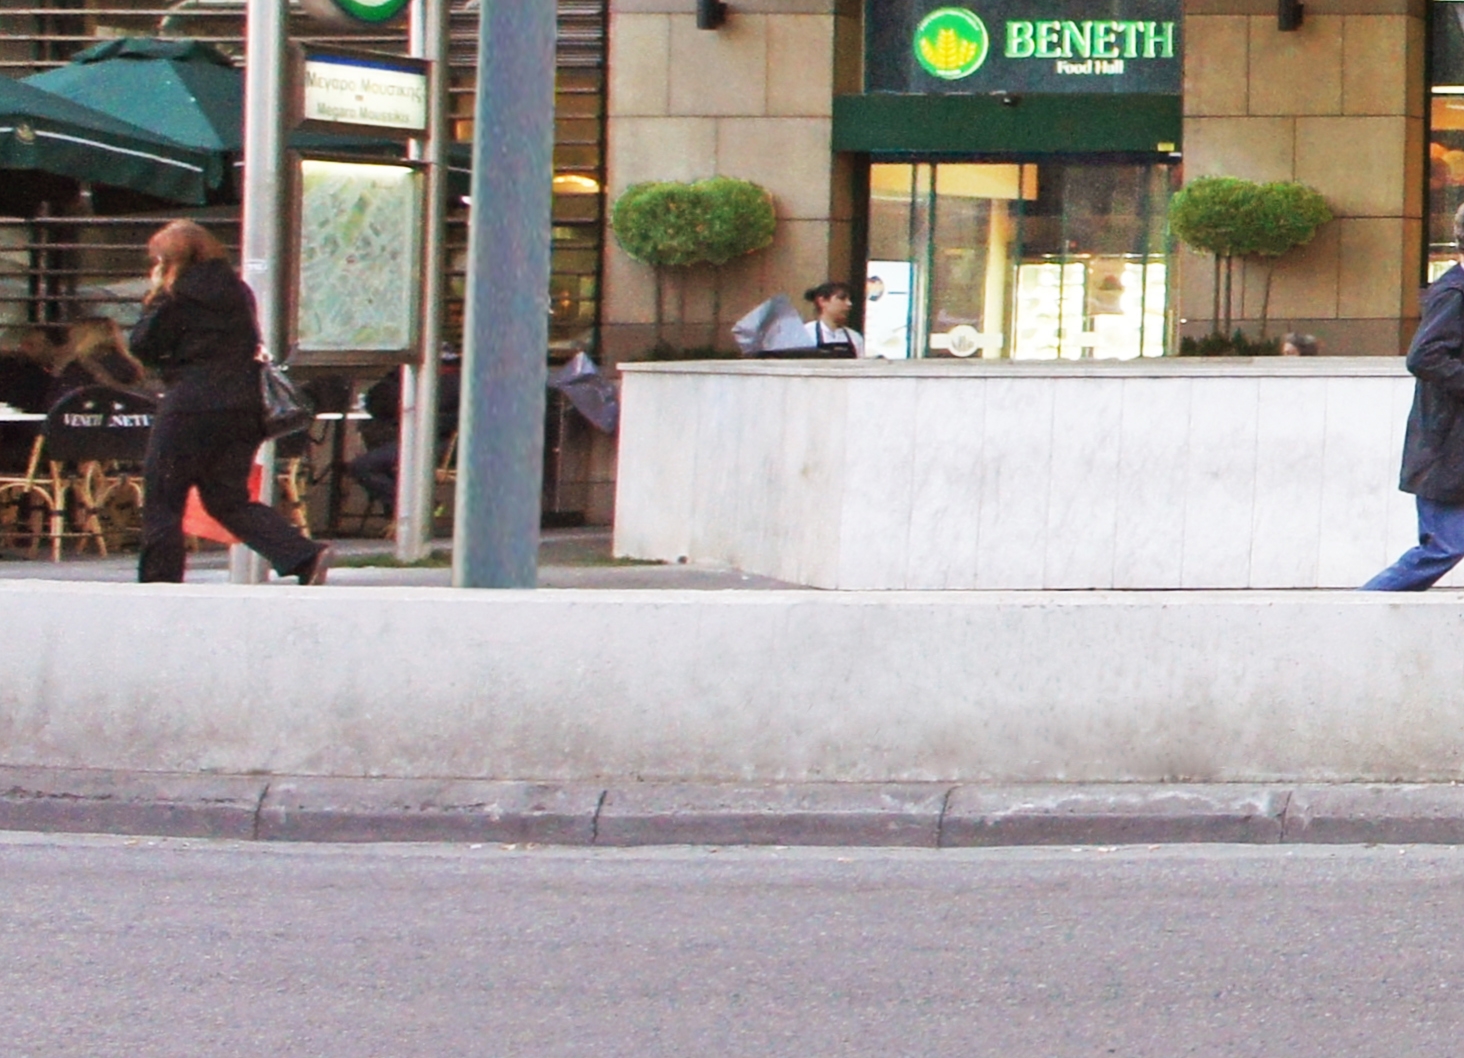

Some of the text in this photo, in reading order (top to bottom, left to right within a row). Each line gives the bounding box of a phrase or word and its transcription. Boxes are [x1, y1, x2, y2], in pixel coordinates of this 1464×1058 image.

[1003, 21, 1175, 59] BENETH
[1057, 59, 1125, 74] Food Hall
